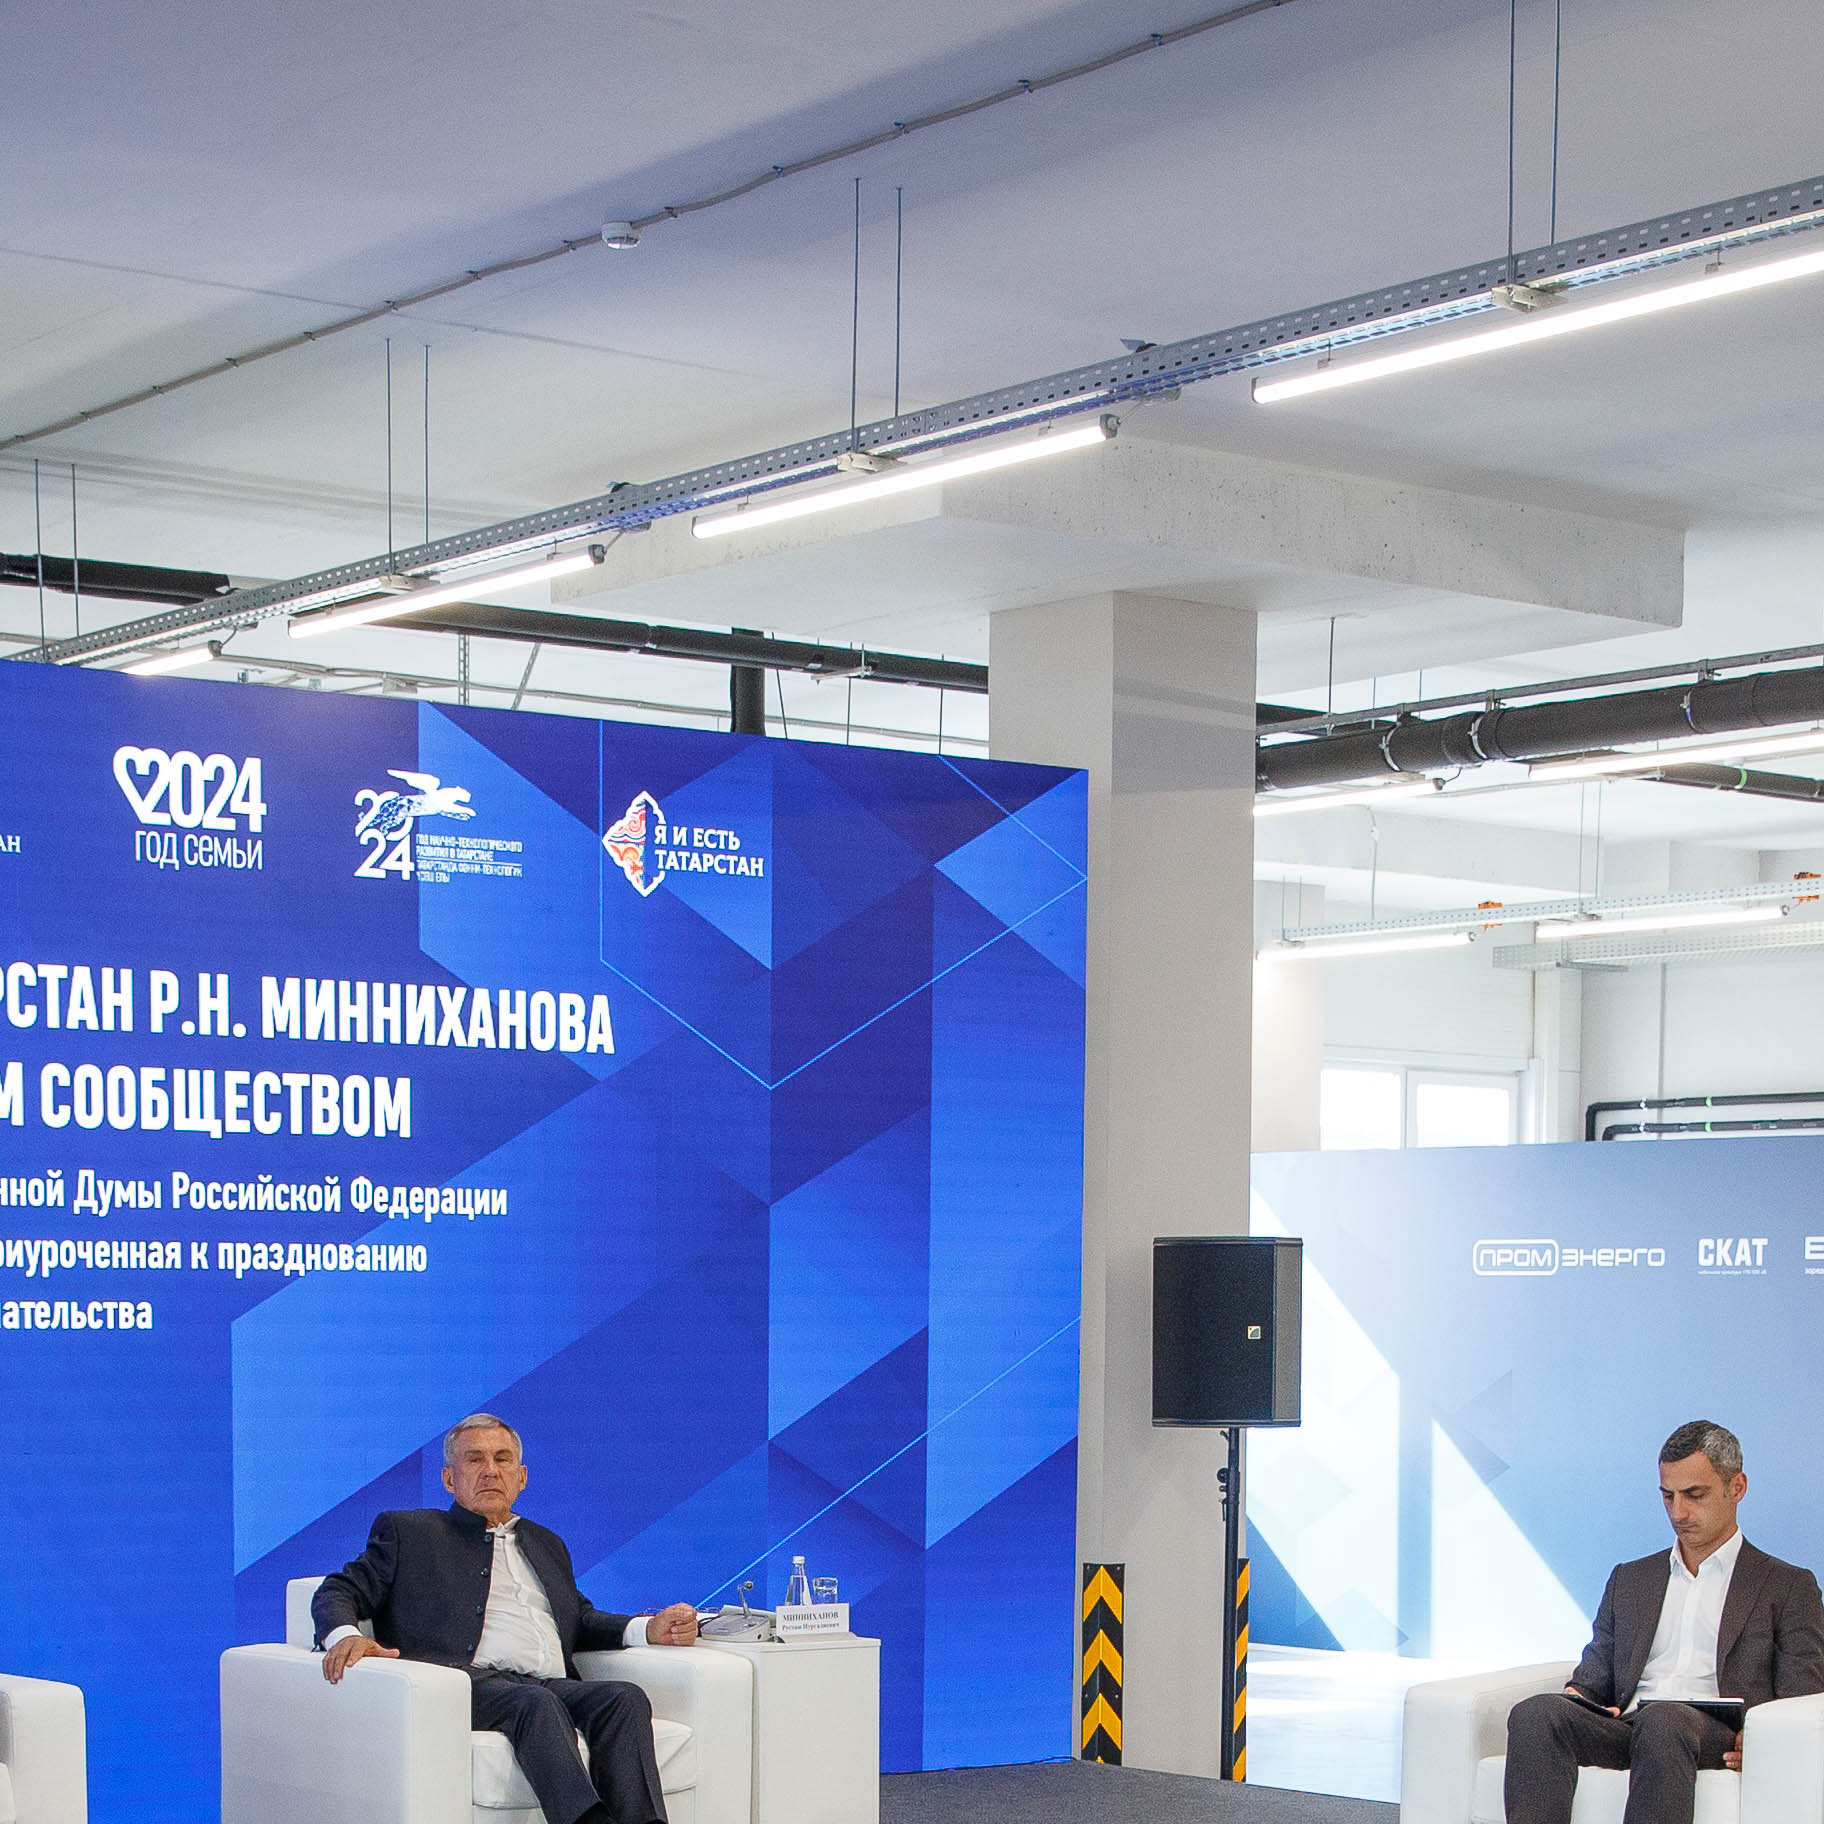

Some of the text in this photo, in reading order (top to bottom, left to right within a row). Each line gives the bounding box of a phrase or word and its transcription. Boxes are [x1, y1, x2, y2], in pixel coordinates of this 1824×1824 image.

[112, 745, 268, 833] 2024
[354, 828, 415, 880] 24
[654, 825, 740, 850] Я И ЕСТЬ
[654, 849, 764, 878] ТАТАРСТАН
[151, 969, 249, 1041] Р.Н.
[261, 976, 615, 1054] МИННИХАНОВА
[40, 1062, 411, 1139] СООБЩЕСТВОМ
[73, 1169, 161, 1217] Думы
[172, 1171, 341, 1212] Российской
[350, 1175, 507, 1223] Федерации
[191, 1241, 209, 1269] к
[218, 1242, 427, 1279] празднованию
[1698, 1238, 1768, 1266] СКАТ
